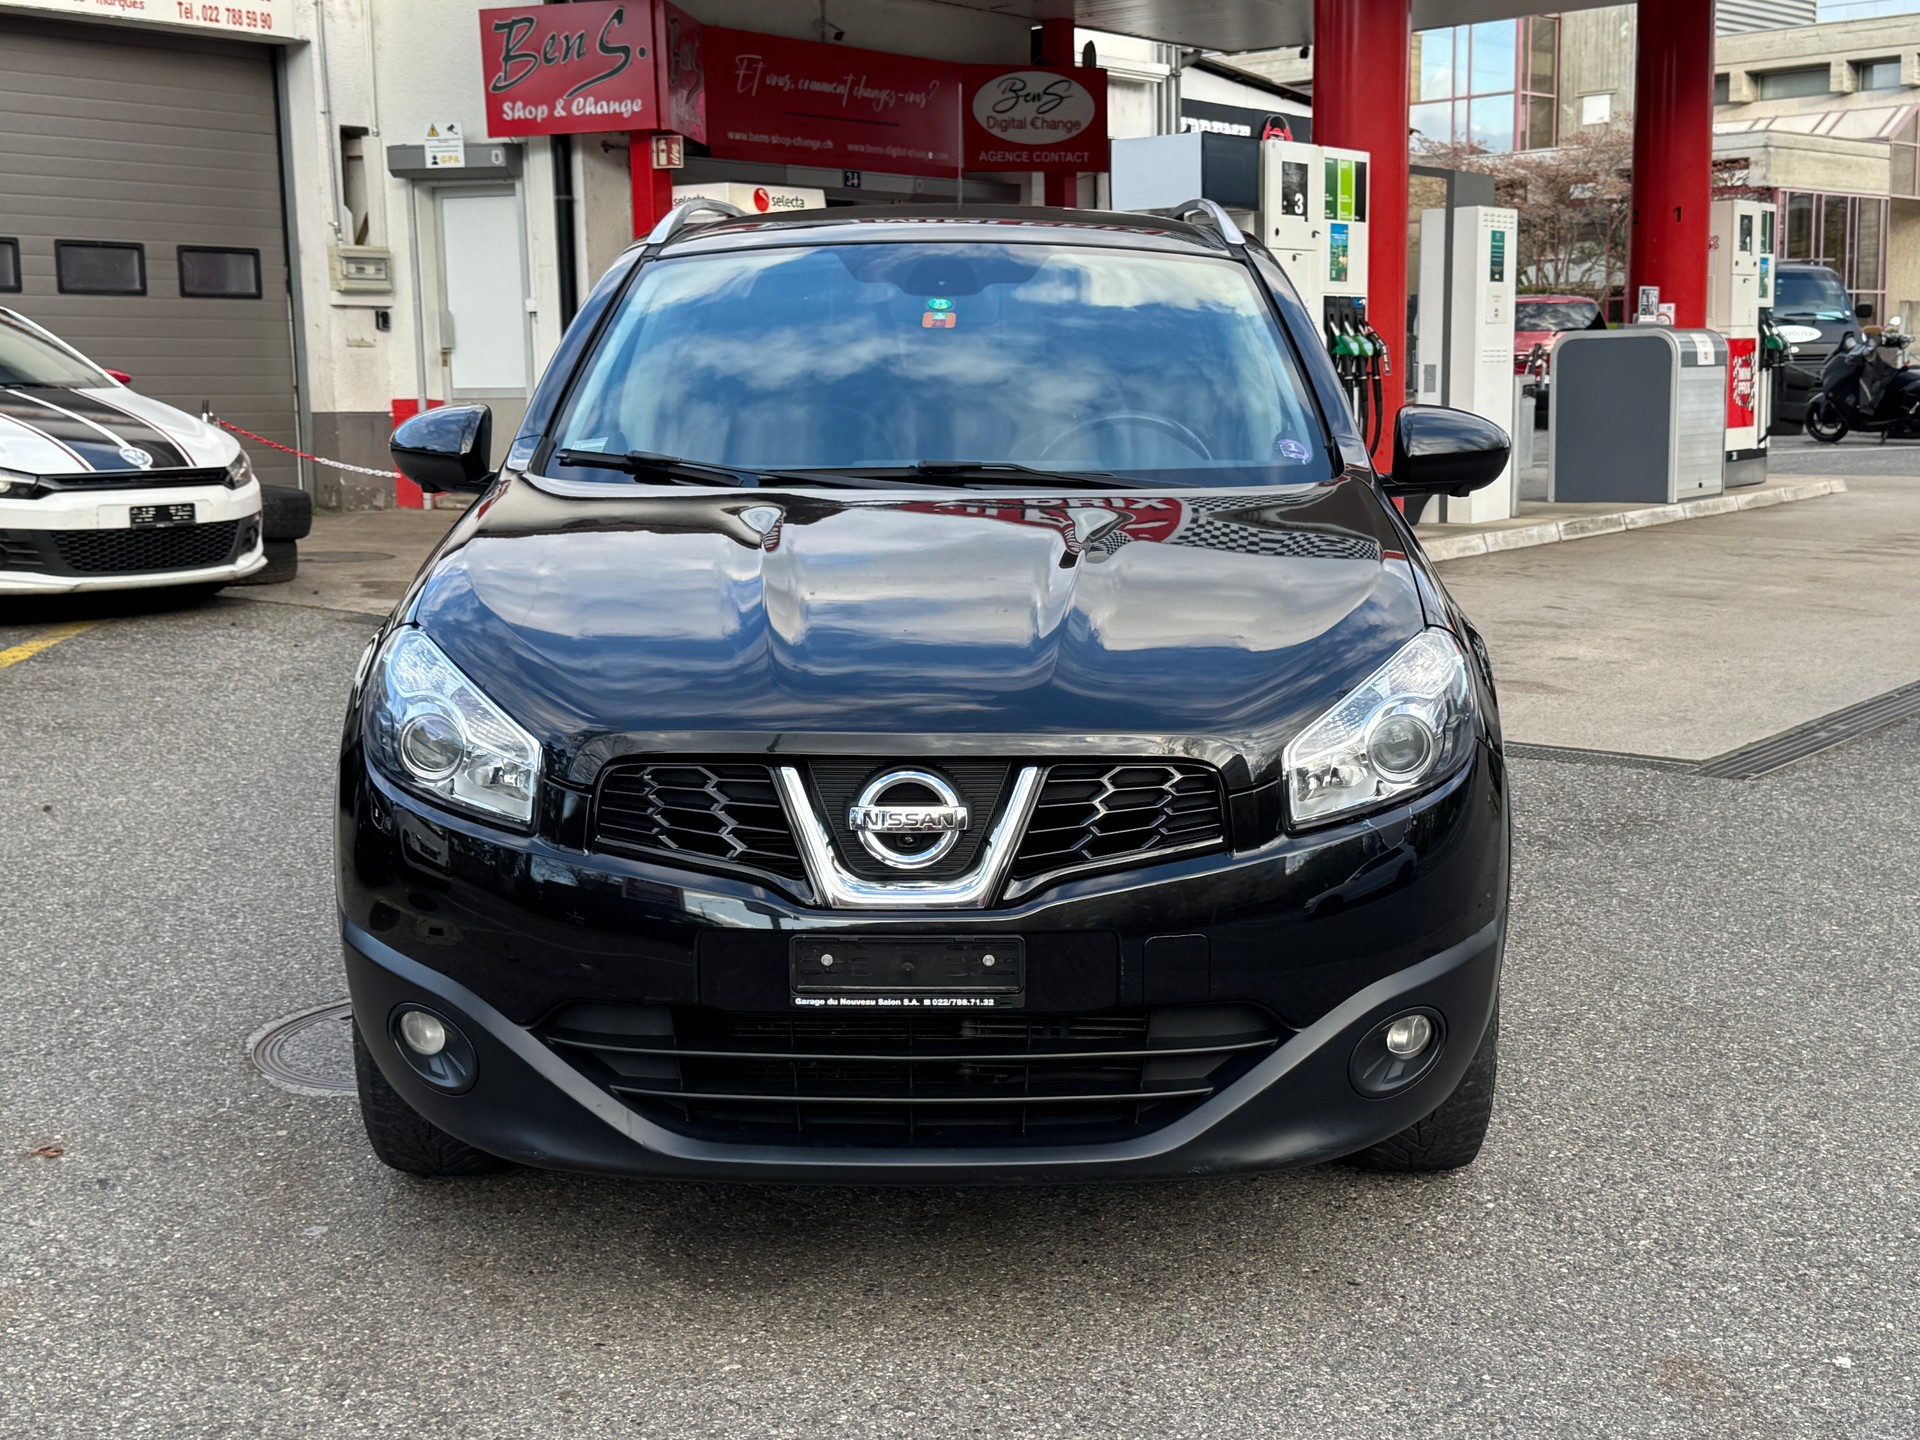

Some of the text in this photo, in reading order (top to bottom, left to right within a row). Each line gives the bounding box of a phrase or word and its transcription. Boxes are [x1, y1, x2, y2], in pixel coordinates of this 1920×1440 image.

[202, 4, 220, 23] 022
[225, 7, 243, 26] 788
[246, 10, 258, 28] 59
[260, 11, 272, 30] 90
[489, 16, 588, 93] Ben
[798, 72, 857, 108] comment
[502, 96, 642, 122] Shop & Change
[986, 116, 1027, 132] Digital
[979, 150, 1090, 163] AGENCE CONTACT
[771, 195, 805, 209] selecta
[1294, 193, 1304, 214] 3
[1673, 206, 1682, 223] 1
[862, 812, 956, 828] NISSAN
[795, 997, 825, 1007] Garage
[827, 997, 838, 1006] du
[839, 998, 876, 1006] Nouveau
